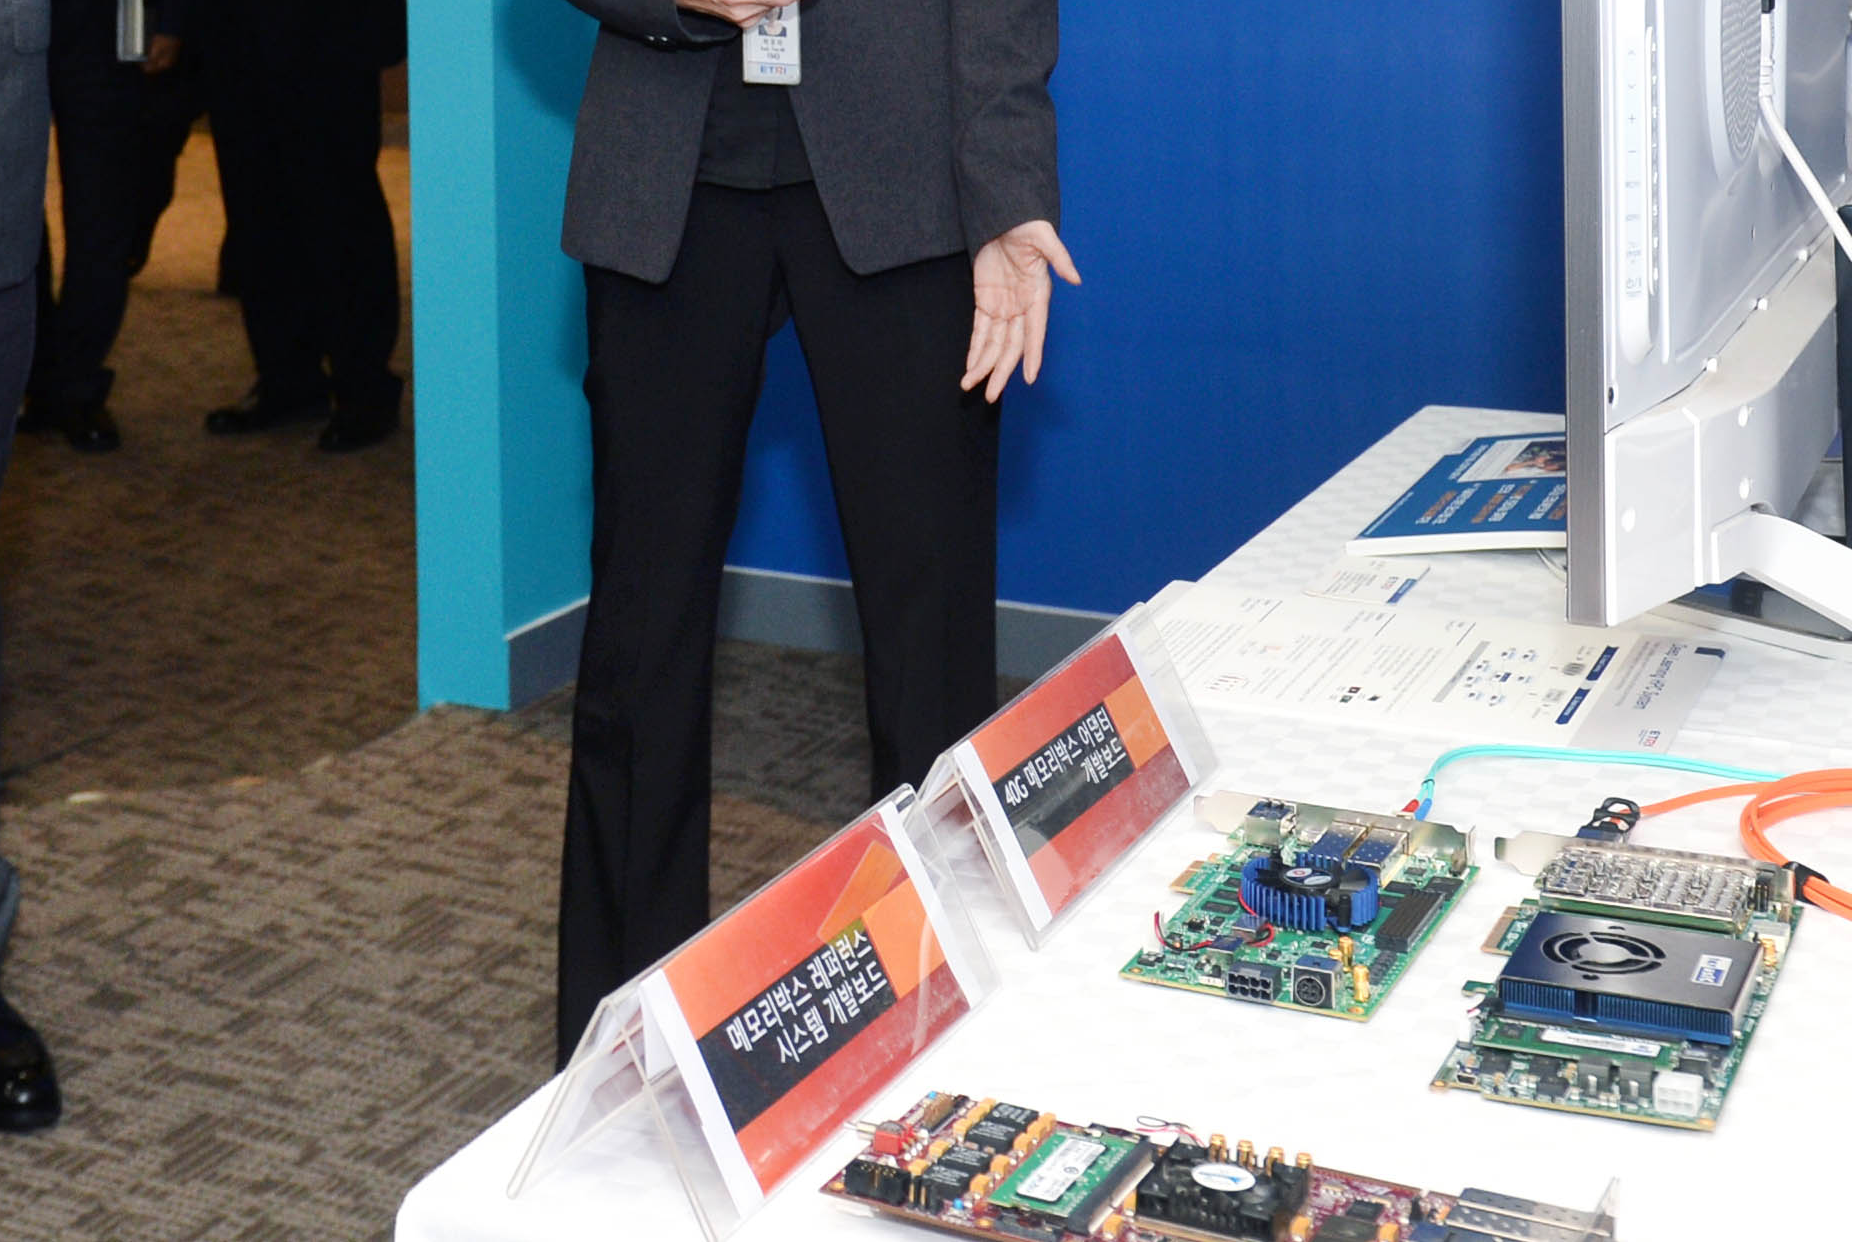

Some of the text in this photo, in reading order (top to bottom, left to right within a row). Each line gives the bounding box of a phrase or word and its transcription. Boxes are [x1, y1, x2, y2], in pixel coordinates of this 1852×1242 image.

[760, 65, 787, 75] ETRI
[1004, 775, 1029, 806] 40G
[1023, 734, 1083, 789] 메모리박스
[1080, 737, 1127, 784] 개발보드
[726, 929, 872, 1051] 메모리박스 레퍼런스
[777, 961, 888, 1063] 시스템 개발보드
